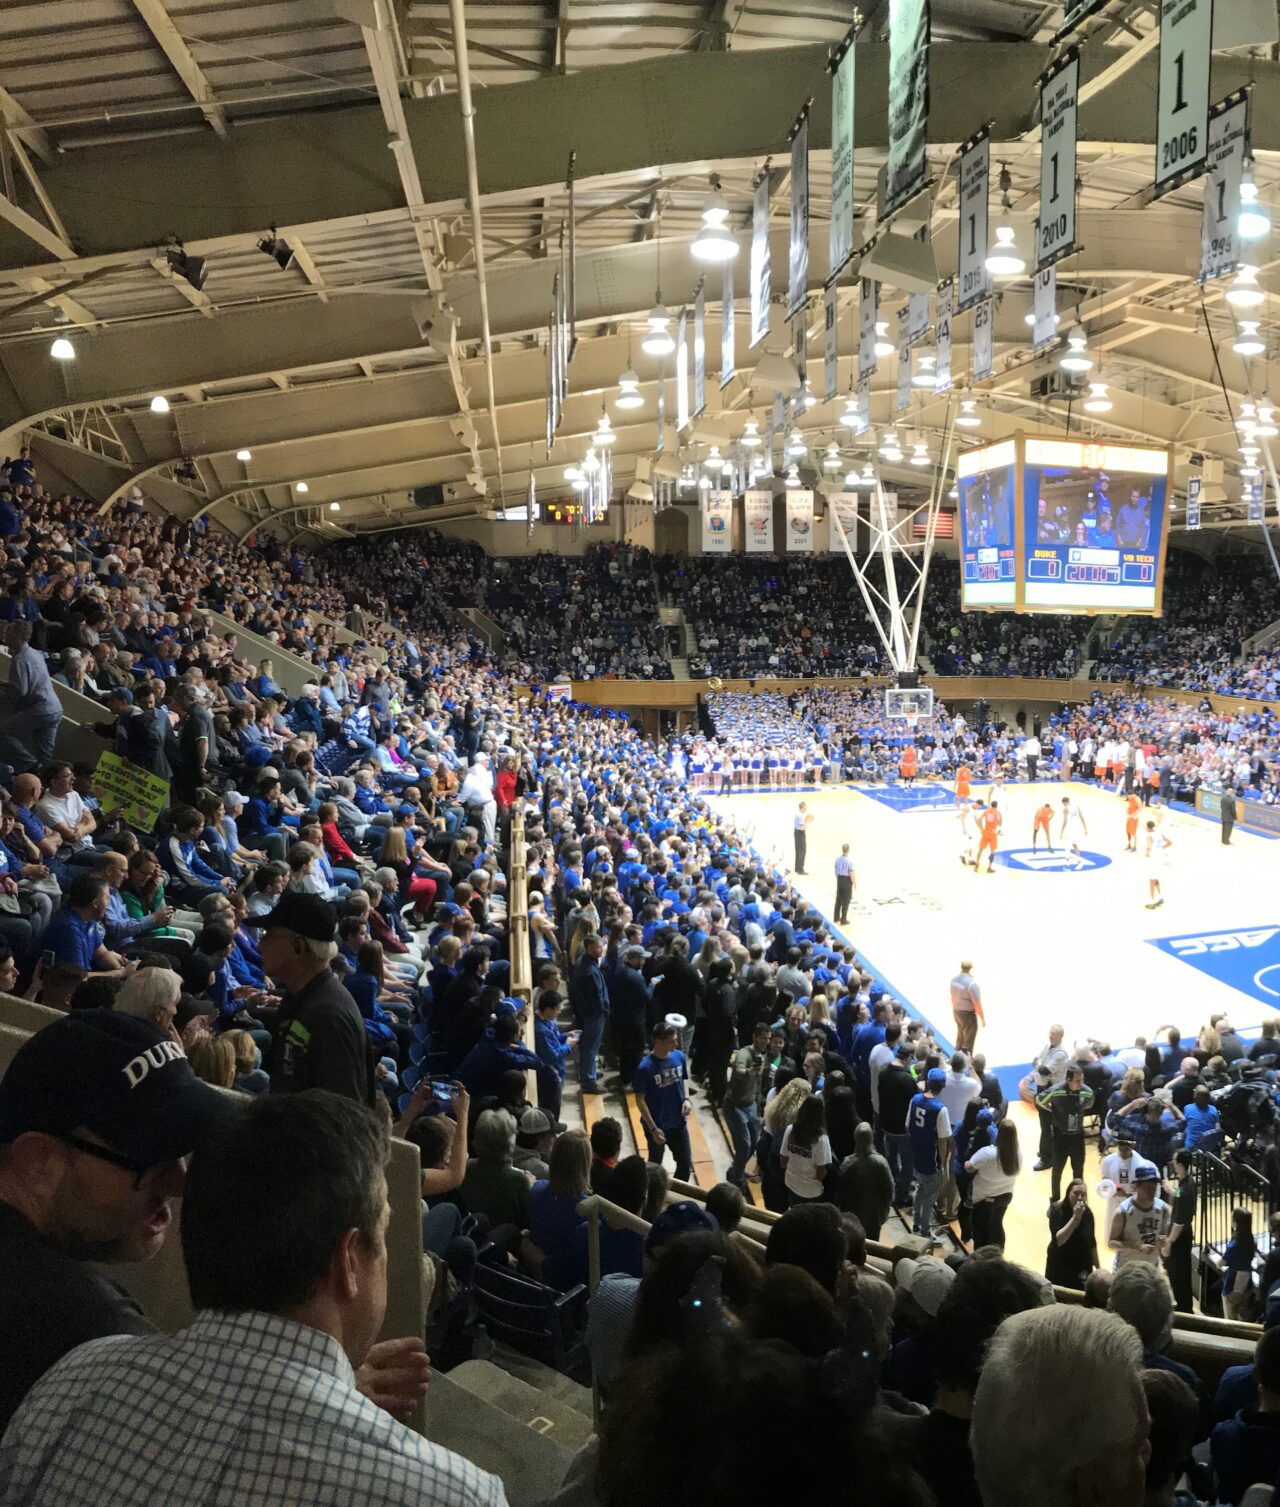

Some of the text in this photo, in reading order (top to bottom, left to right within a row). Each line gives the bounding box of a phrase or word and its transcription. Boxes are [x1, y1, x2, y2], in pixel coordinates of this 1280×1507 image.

[1173, 50, 1188, 115] 1
[1163, 126, 1198, 169] 2006
[1050, 152, 1059, 203] 1
[1216, 179, 1228, 223] 1
[968, 213, 976, 256] 1
[1043, 214, 1066, 248] 2010
[1034, 550, 1056, 559] DUKE
[121, 1041, 188, 1089] DUK
